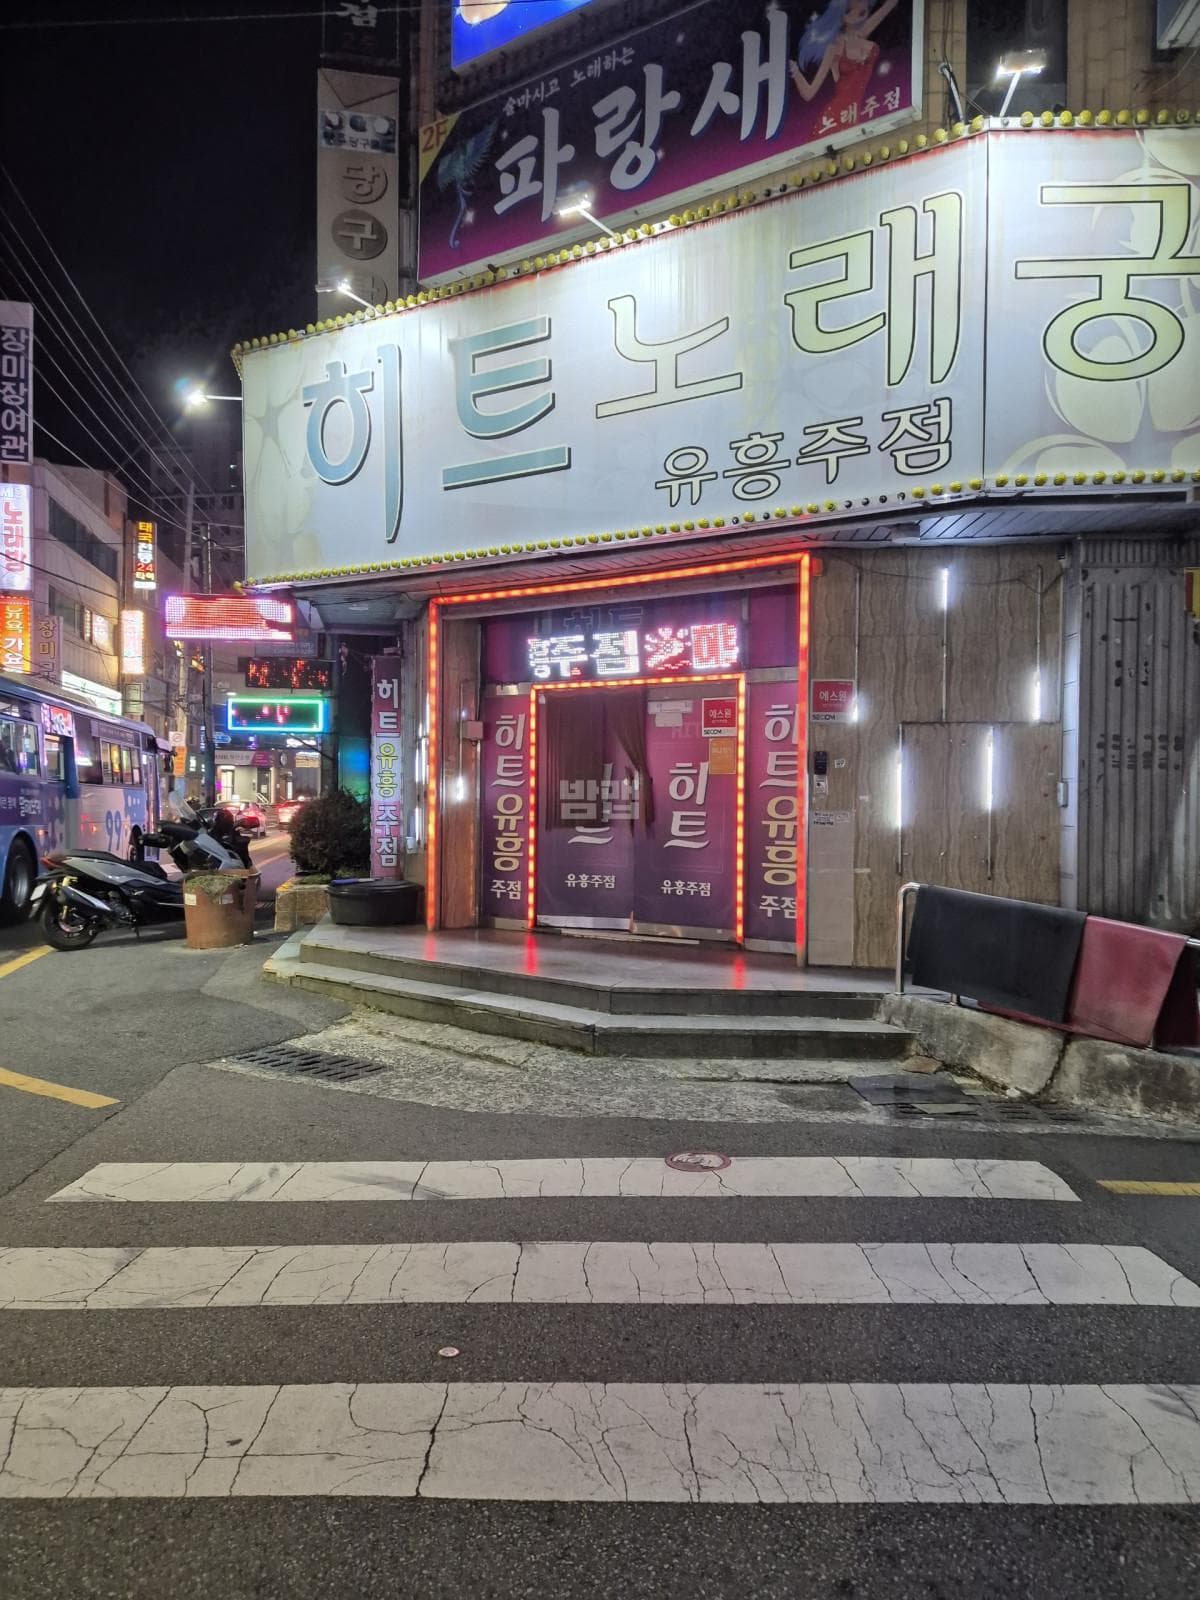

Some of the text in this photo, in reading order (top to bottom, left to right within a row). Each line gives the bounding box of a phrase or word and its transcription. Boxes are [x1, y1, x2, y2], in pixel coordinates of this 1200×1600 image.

[421, 121, 447, 152] 2F
[493, 5, 790, 223] 파랑새
[817, 86, 901, 134] 노래주점
[0, 325, 29, 461] 장미장여관
[654, 396, 954, 508] 유흥주점
[376, 678, 400, 738] 히트
[491, 713, 526, 788] 히트
[759, 703, 799, 788] 히트
[376, 804, 399, 867] 주점
[493, 793, 524, 872] 유흥
[663, 761, 711, 848] 히트
[490, 879, 522, 900] 주점
[565, 873, 616, 889] 유흥주점
[661, 879, 711, 897] 유흥주점
